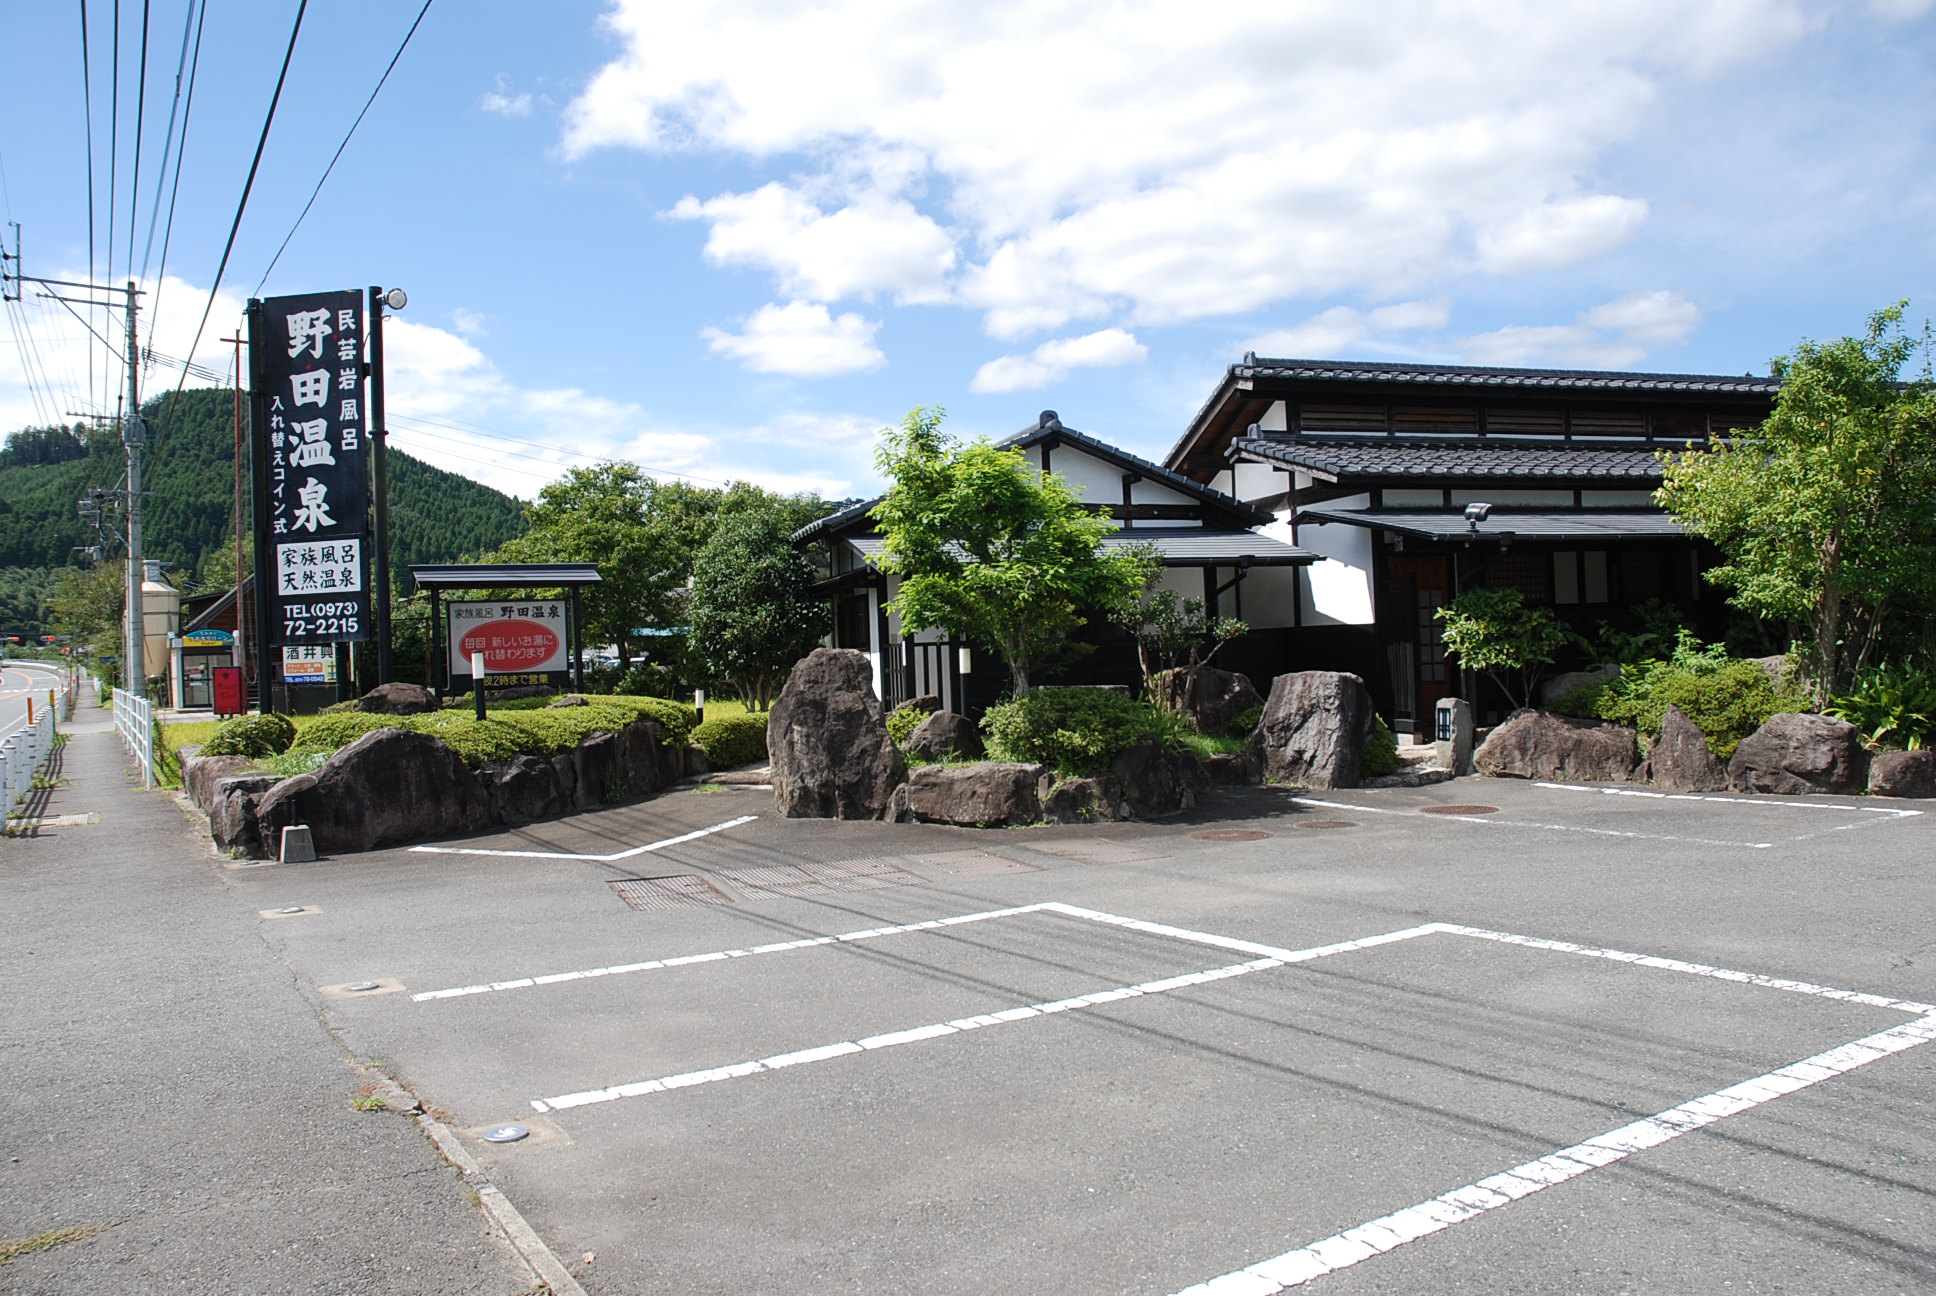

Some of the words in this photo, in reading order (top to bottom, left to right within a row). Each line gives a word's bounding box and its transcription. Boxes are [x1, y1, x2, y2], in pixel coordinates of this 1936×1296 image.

[337, 309, 359, 451] 民芸岩風呂
[286, 307, 338, 533] 野田温泉
[270, 395, 288, 534] 入れ替えコイン式
[281, 544, 356, 569] 家族風呂
[282, 567, 356, 591] 天然温泉
[284, 601, 359, 619] TEL(0973)
[455, 608, 493, 618] 家族風呂
[500, 605, 560, 619] 野田温泉
[284, 617, 359, 637] 72-2215
[465, 638, 485, 648] 毎回
[492, 635, 553, 647] 新しいお湯に
[484, 647, 545, 660] れ替わります
